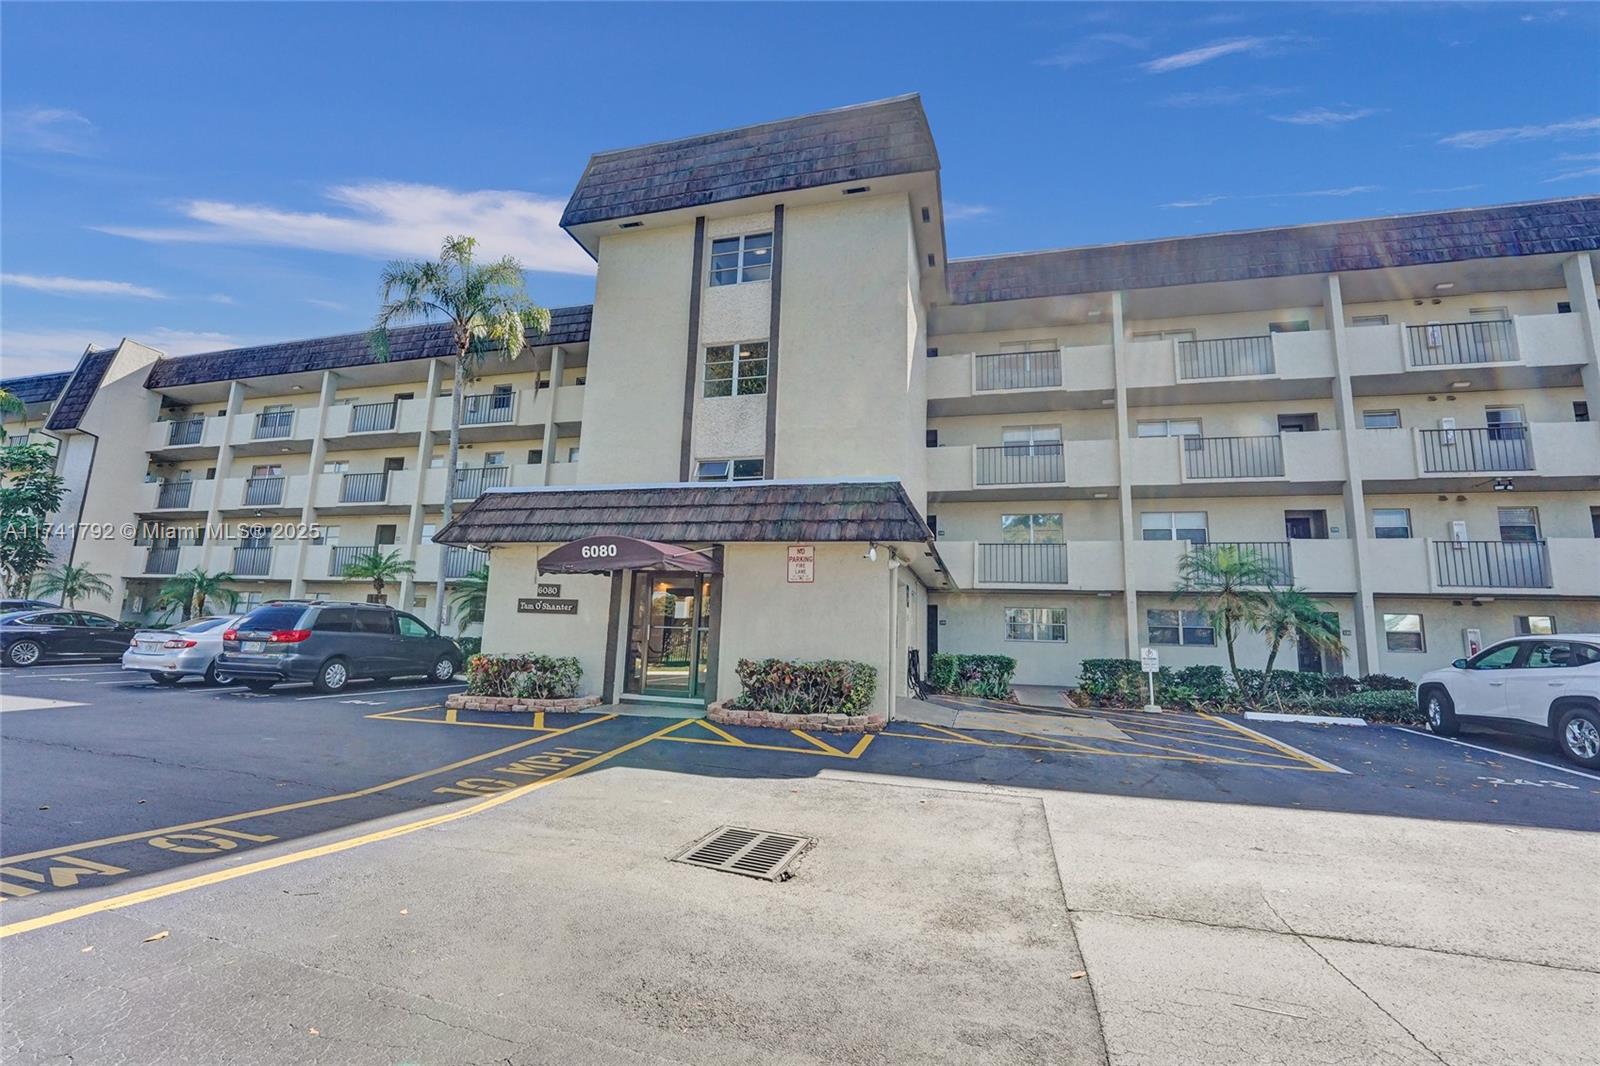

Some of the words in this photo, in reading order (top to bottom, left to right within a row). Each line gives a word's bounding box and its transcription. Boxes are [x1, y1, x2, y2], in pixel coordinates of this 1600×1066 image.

[582, 545, 617, 558] 6080
[538, 587, 557, 595] 6080
[432, 777, 517, 797] 10
[493, 747, 602, 776] MPH
